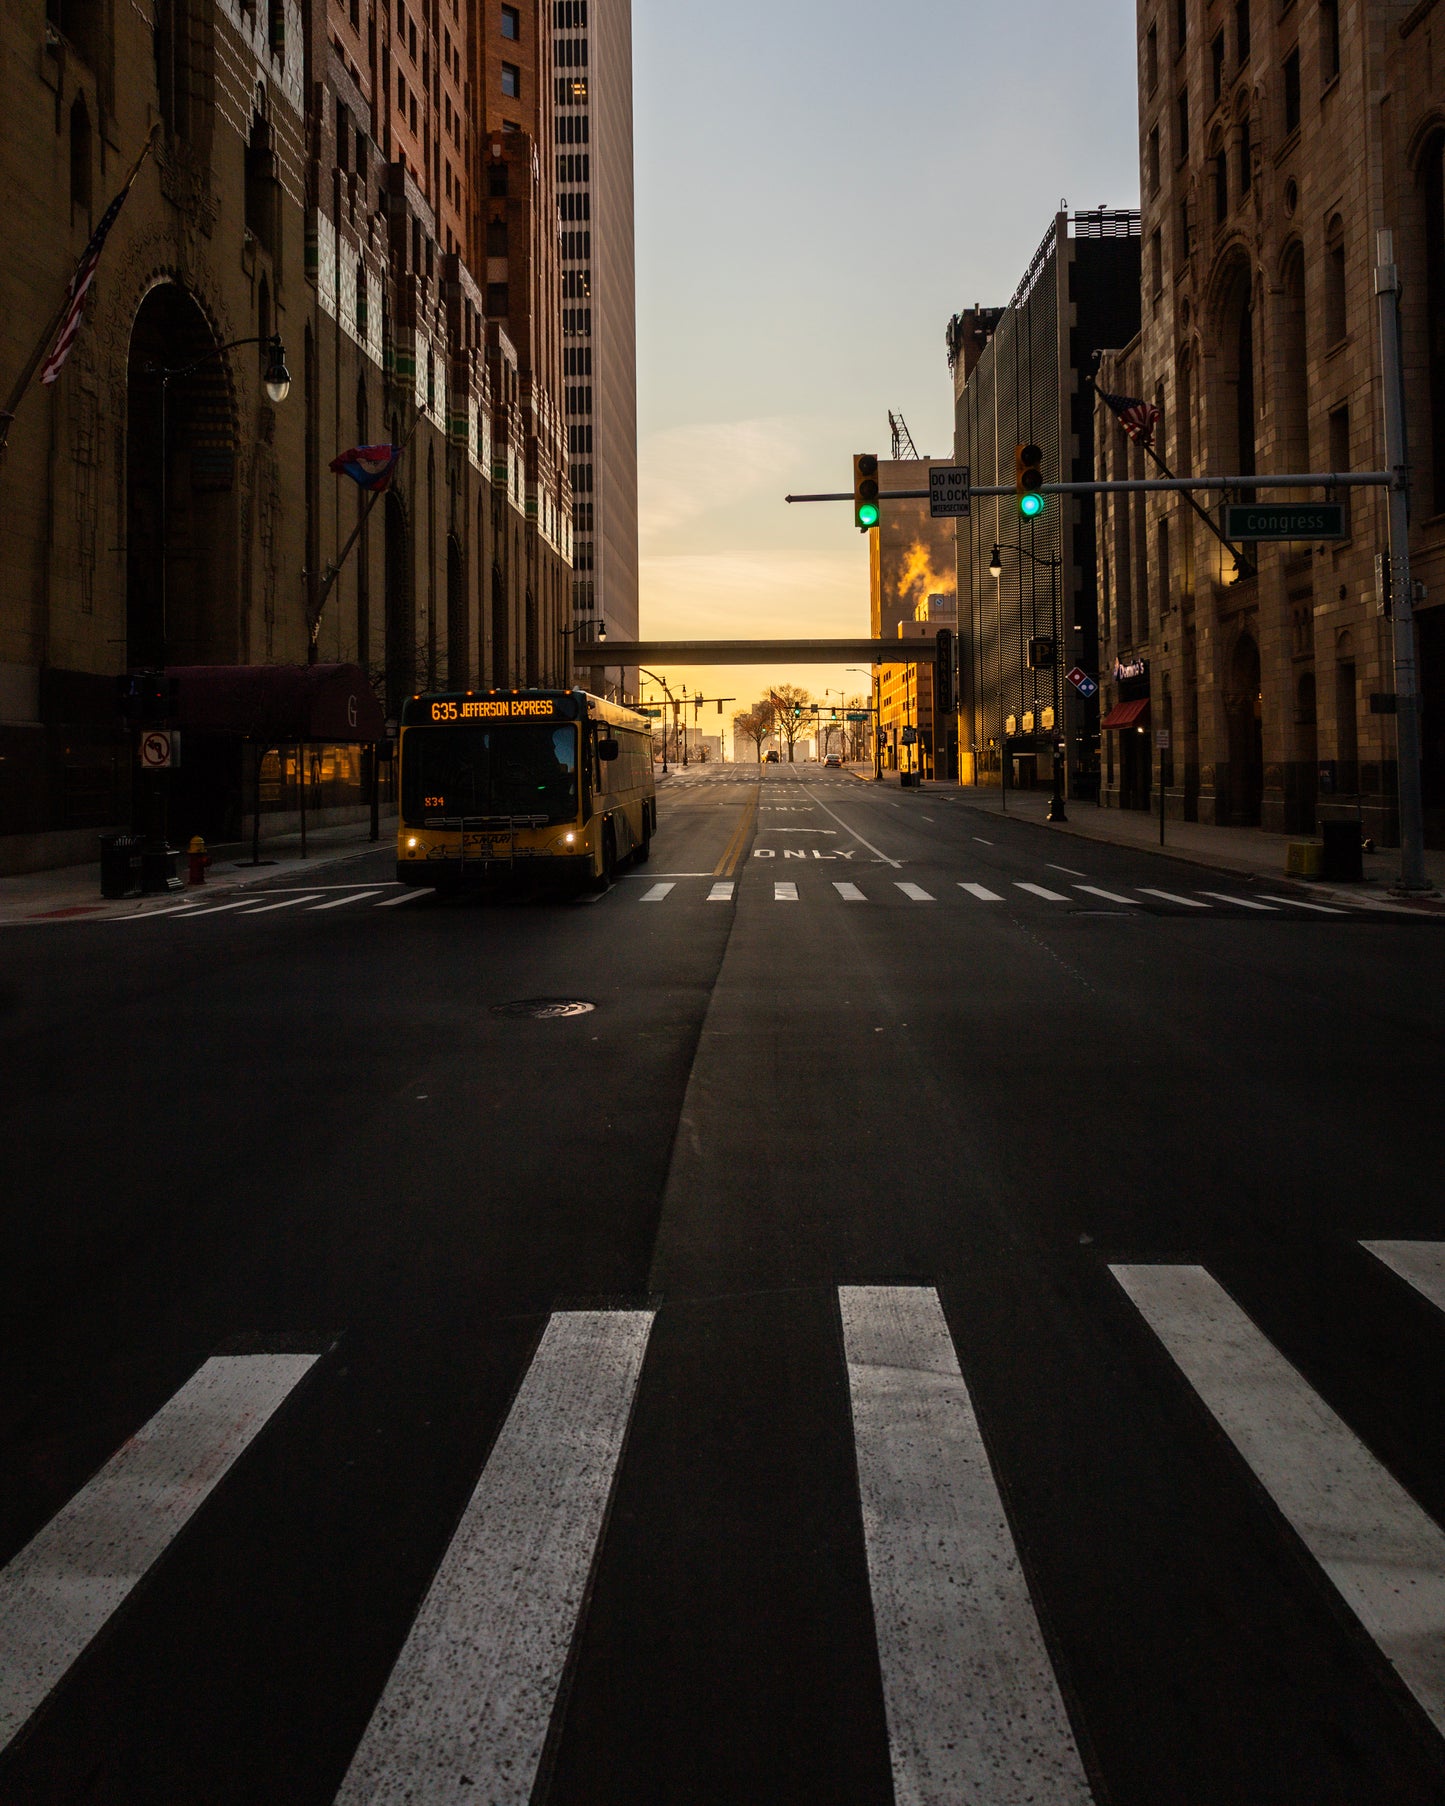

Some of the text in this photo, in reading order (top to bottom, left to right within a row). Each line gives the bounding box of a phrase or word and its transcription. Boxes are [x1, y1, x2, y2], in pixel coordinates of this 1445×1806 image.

[932, 473, 968, 485] DO NOT
[932, 490, 968, 501] BLOCK
[1247, 514, 1325, 533] Congress
[1035, 643, 1049, 662] P
[347, 695, 357, 727] G
[431, 699, 553, 721] 635 JEFFERSON EXPRESS
[470, 833, 519, 844] SMART
[753, 849, 856, 859] ONLY
